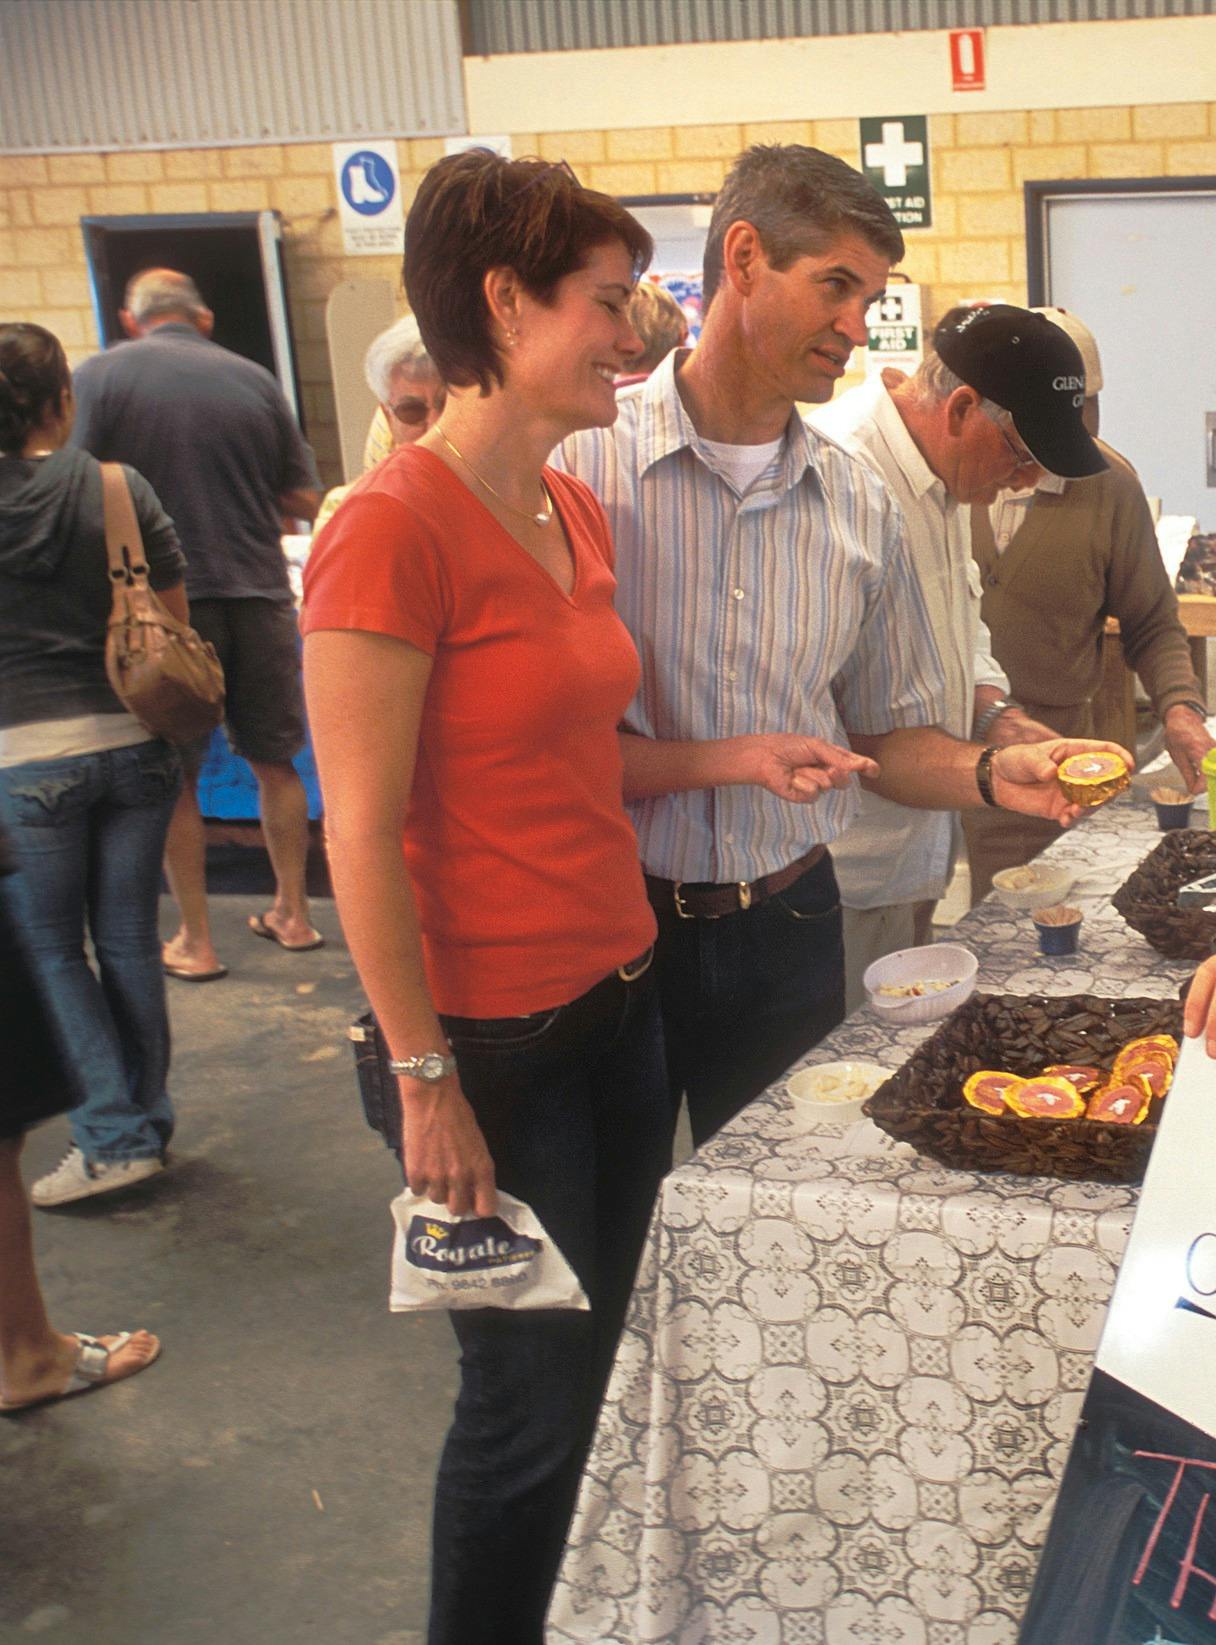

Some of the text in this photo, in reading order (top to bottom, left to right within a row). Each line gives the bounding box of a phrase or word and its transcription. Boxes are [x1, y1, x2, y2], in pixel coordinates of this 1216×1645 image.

[904, 196, 925, 209] AID
[869, 326, 914, 340] FIRST
[878, 337, 907, 351] AID
[411, 1235, 511, 1265] Royale
